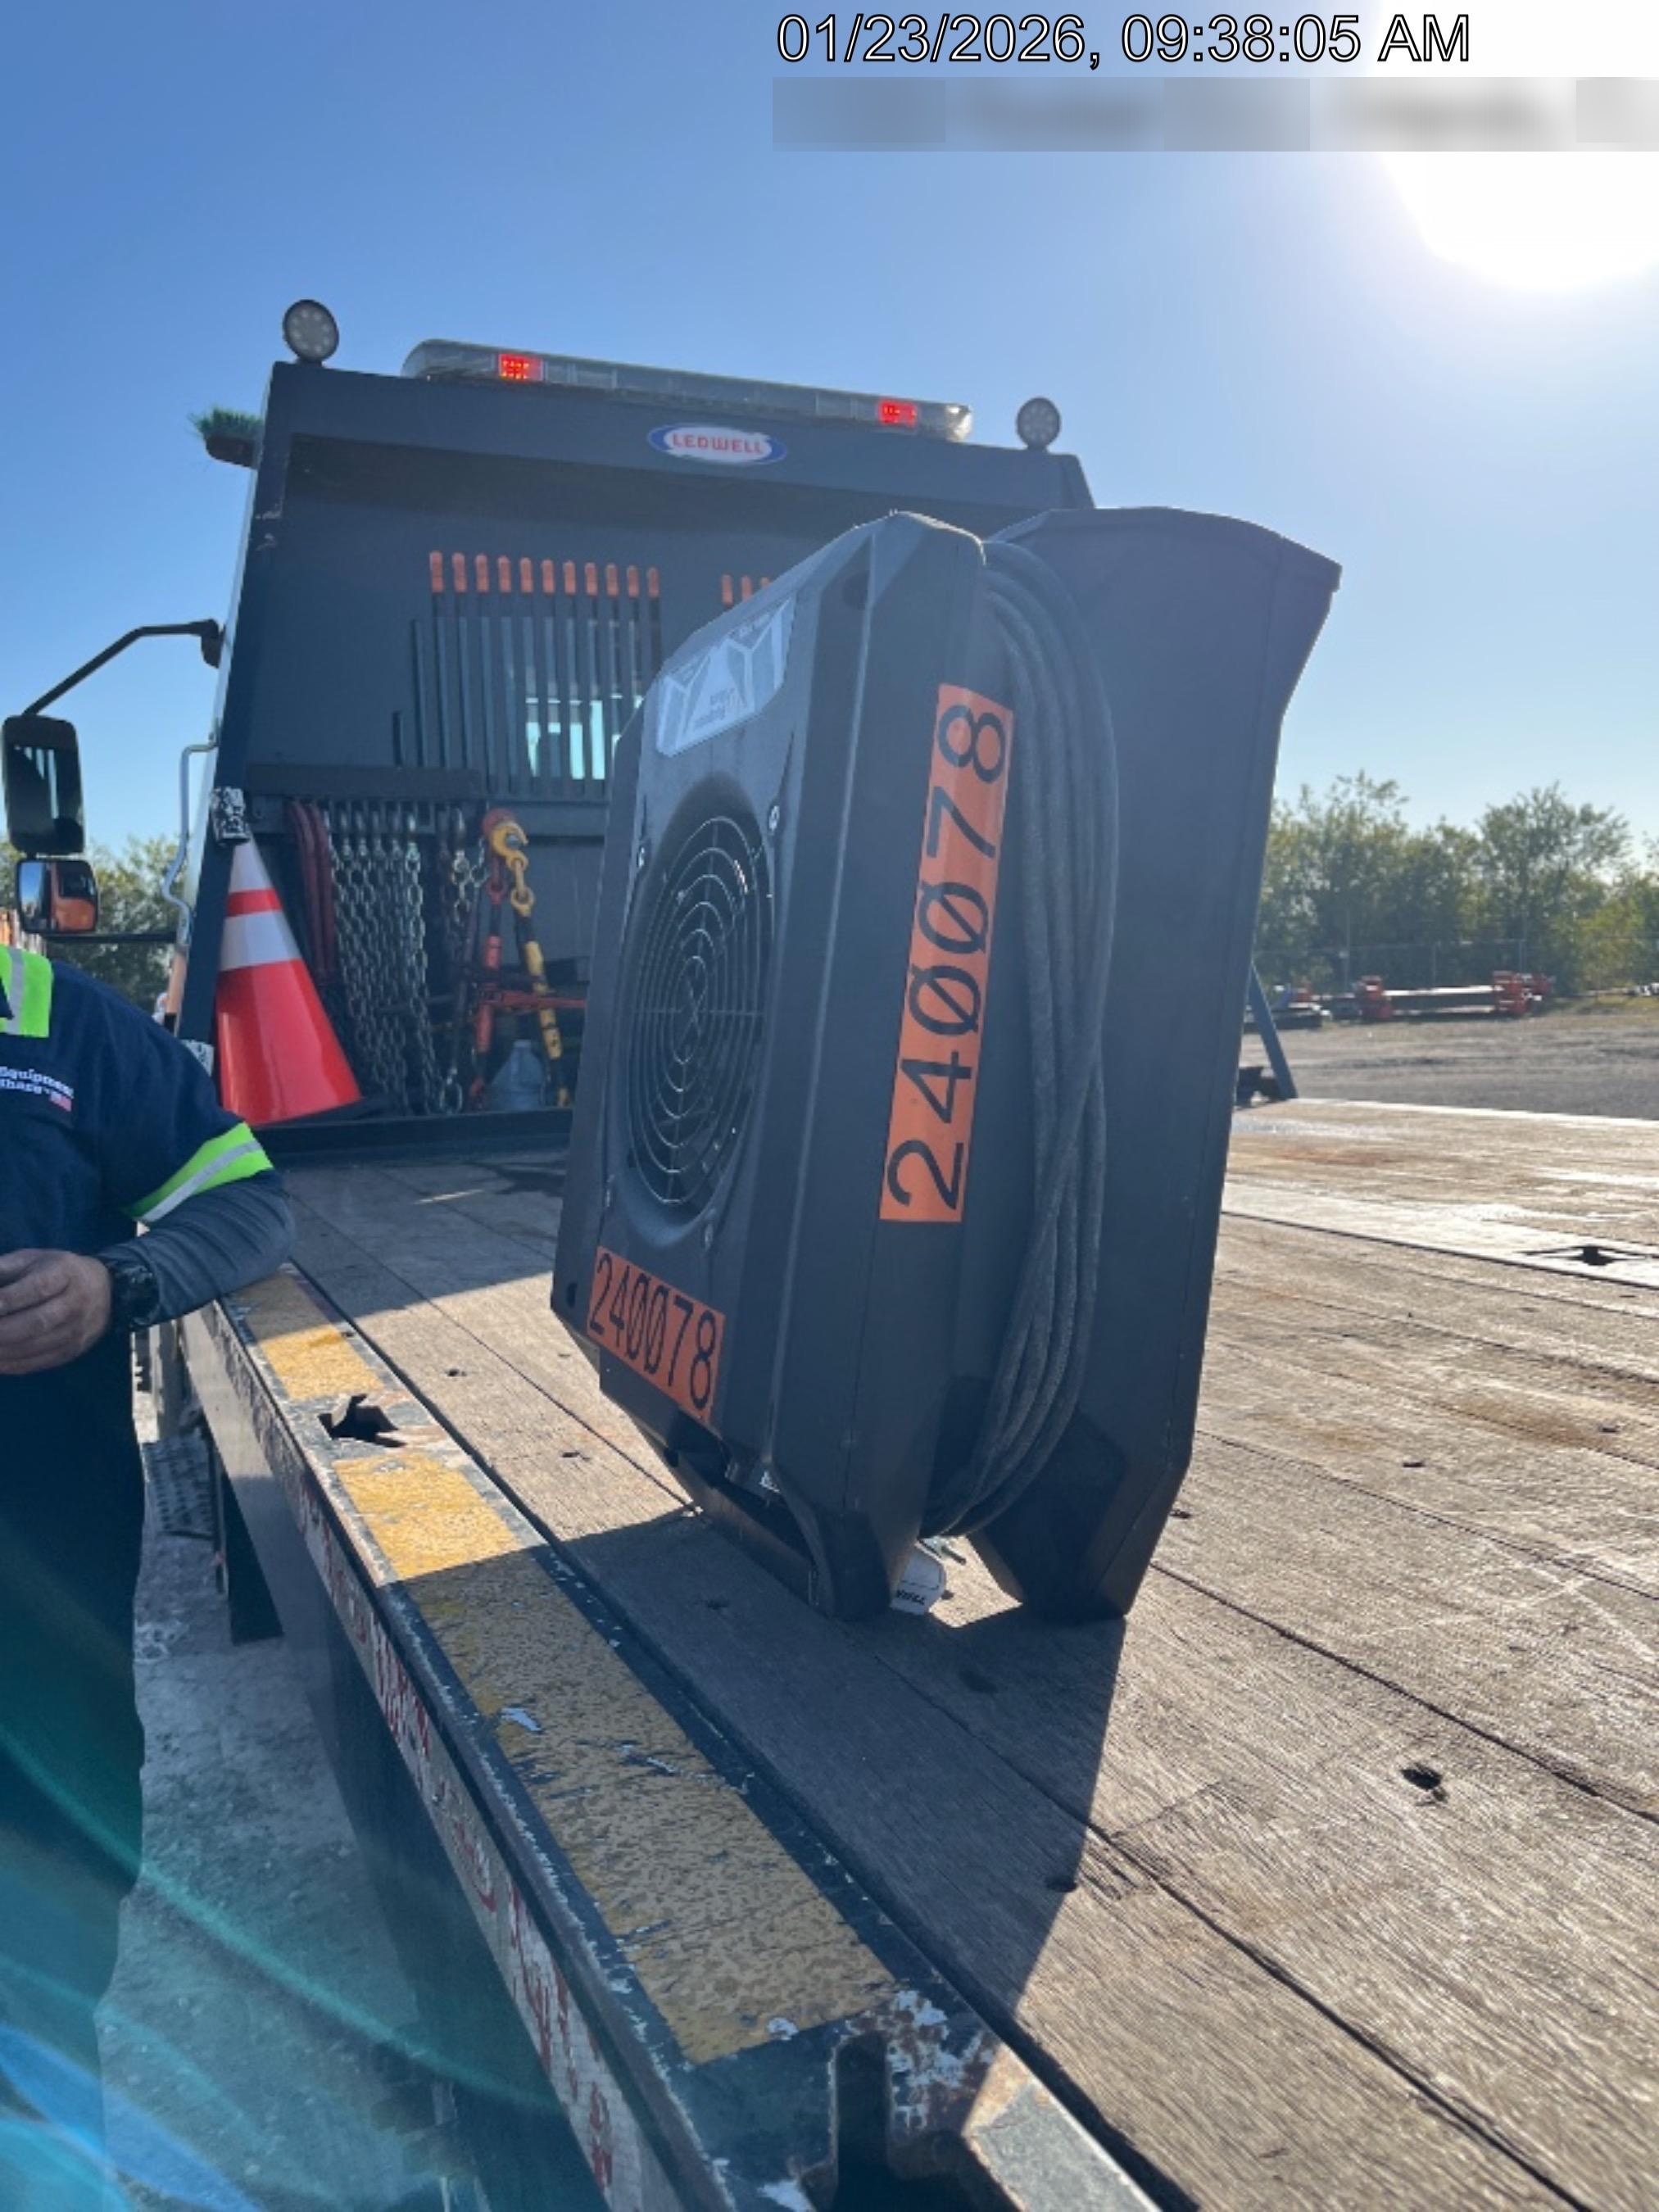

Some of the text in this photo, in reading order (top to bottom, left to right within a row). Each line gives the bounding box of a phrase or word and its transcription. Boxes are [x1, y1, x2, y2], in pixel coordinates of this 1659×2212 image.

[671, 433, 763, 454] LEDWELL
[886, 704, 1006, 1211] 240078
[590, 1253, 715, 1409] 240078
